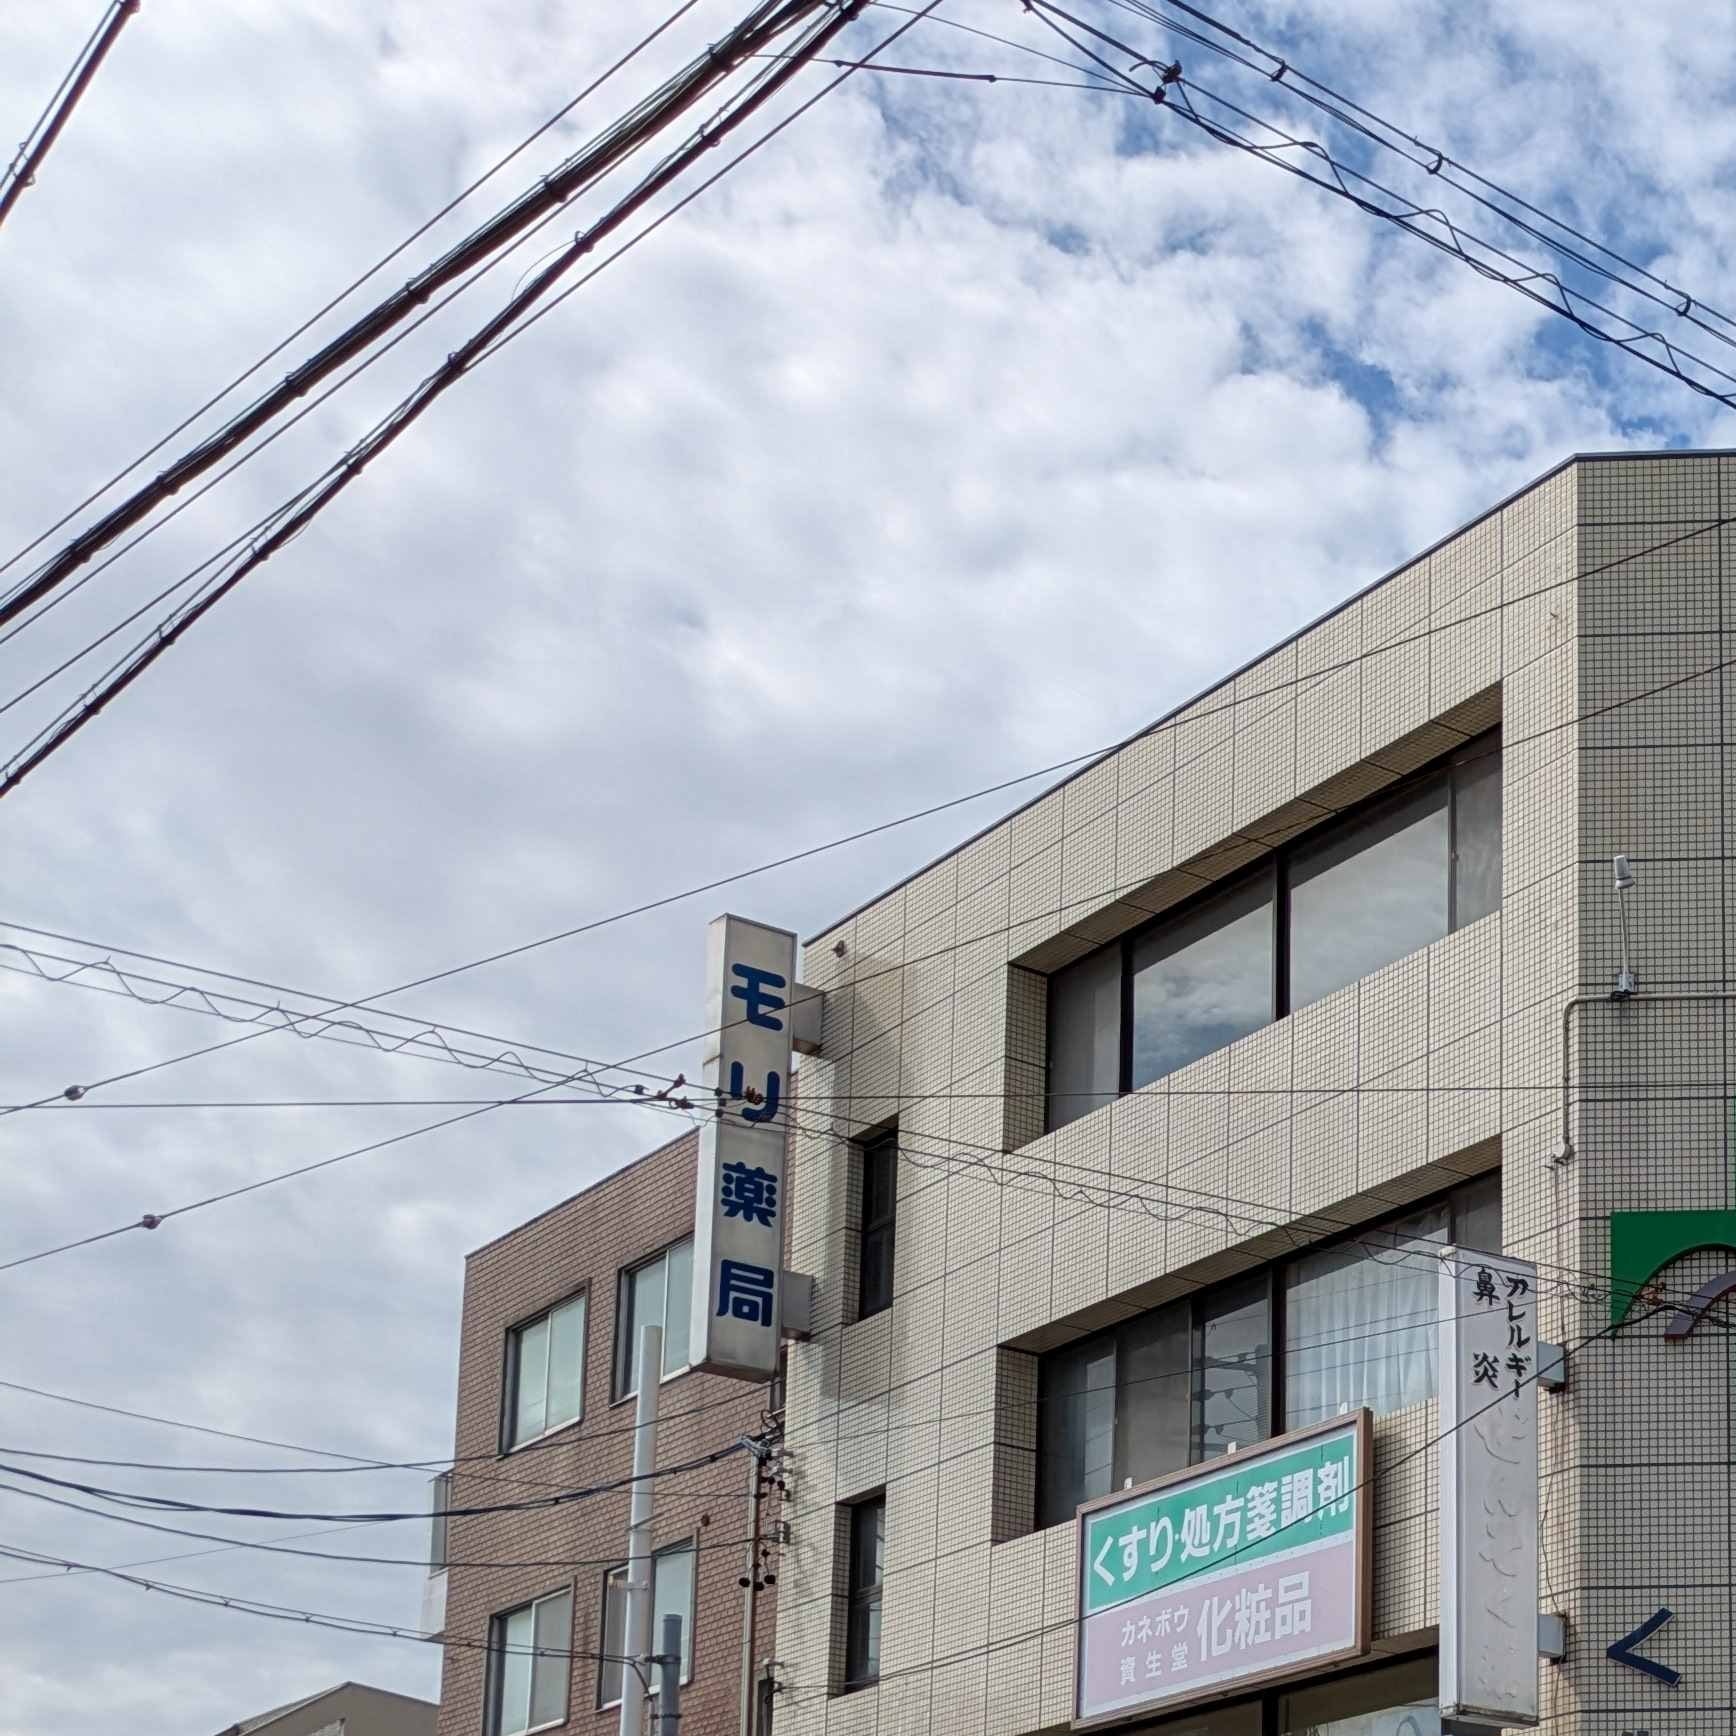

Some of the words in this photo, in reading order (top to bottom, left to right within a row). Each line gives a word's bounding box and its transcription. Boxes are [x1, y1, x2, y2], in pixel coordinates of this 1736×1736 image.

[716, 962, 786, 1328] モリ薬局
[1471, 1268, 1499, 1390] 鼻炎
[1120, 1604, 1191, 1647] カネボウ
[1196, 1571, 1312, 1663] 化粧品
[1120, 1641, 1190, 1687] 資生堂
